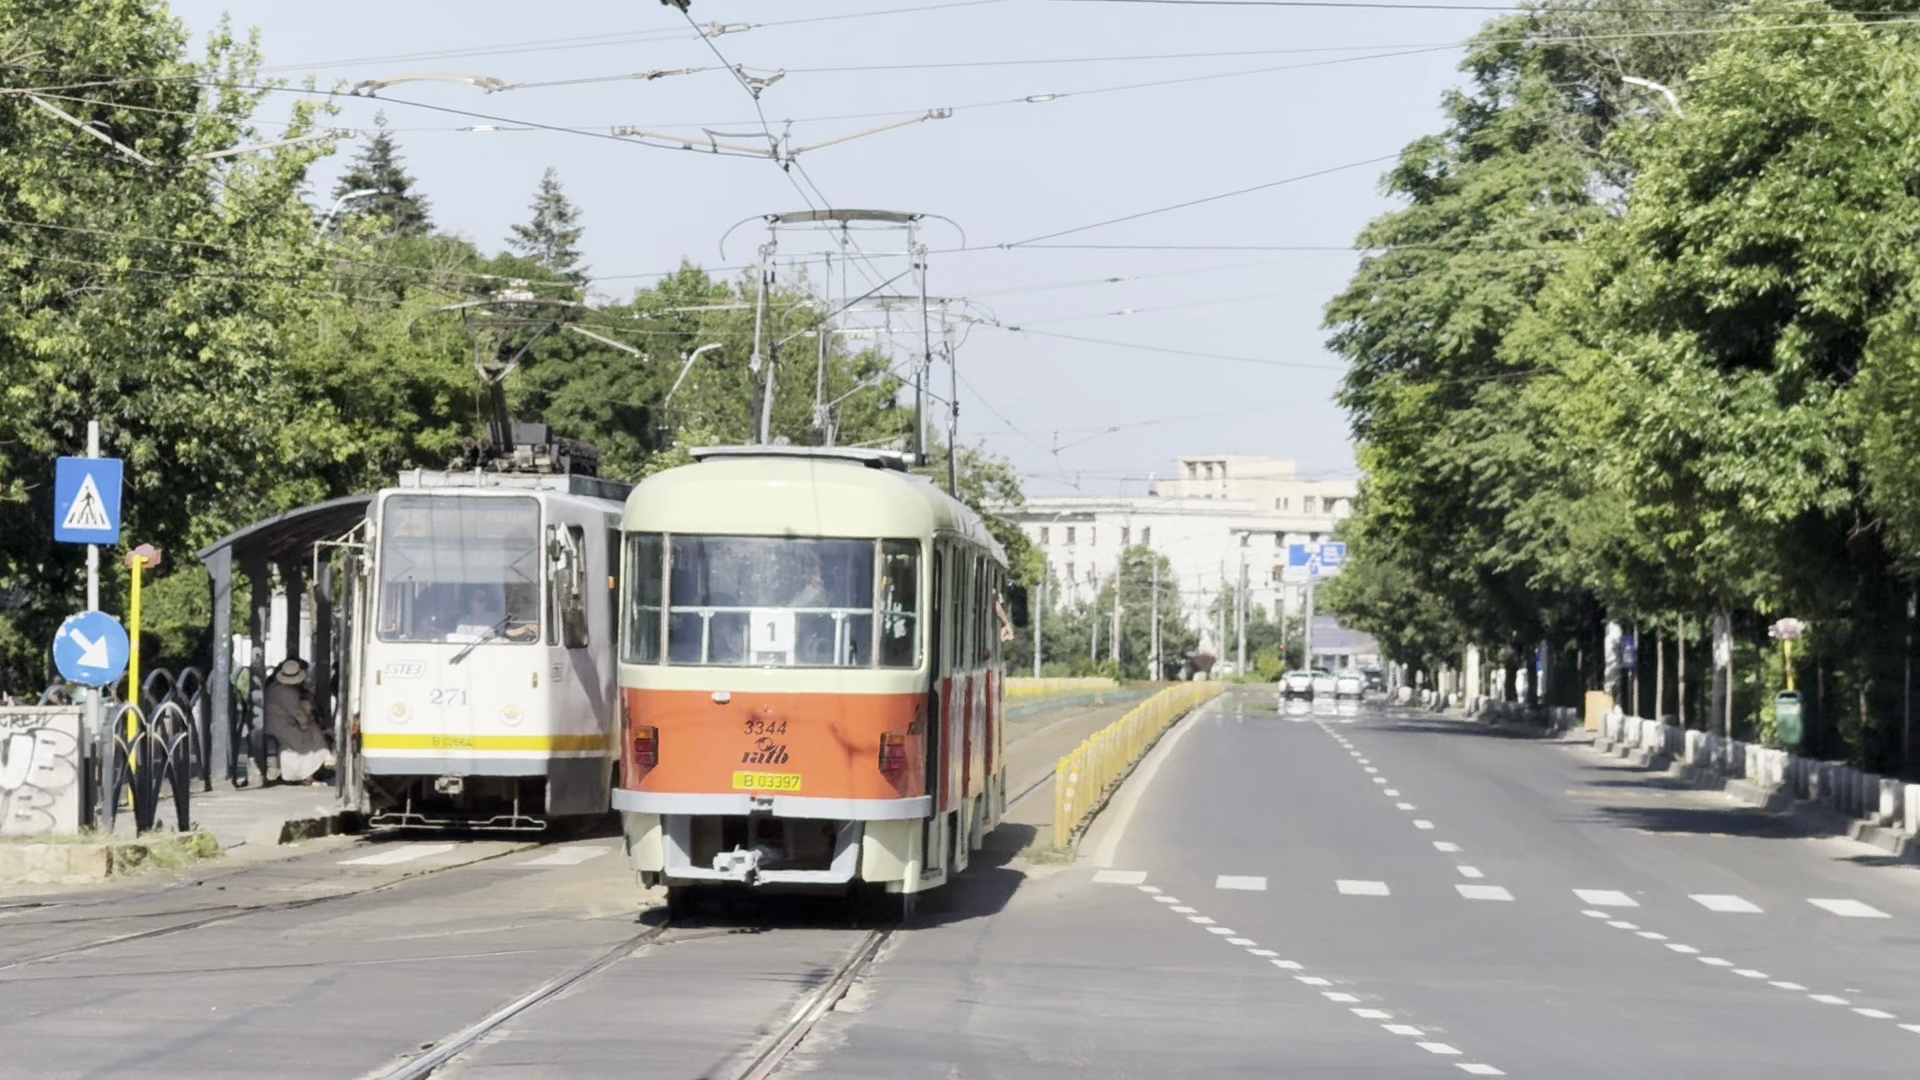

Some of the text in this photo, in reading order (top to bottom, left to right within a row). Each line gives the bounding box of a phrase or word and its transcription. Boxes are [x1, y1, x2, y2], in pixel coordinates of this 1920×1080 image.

[766, 621, 776, 641] 1
[429, 685, 469, 706] 271
[744, 719, 787, 735] 3344
[743, 774, 800, 789] B 03397
